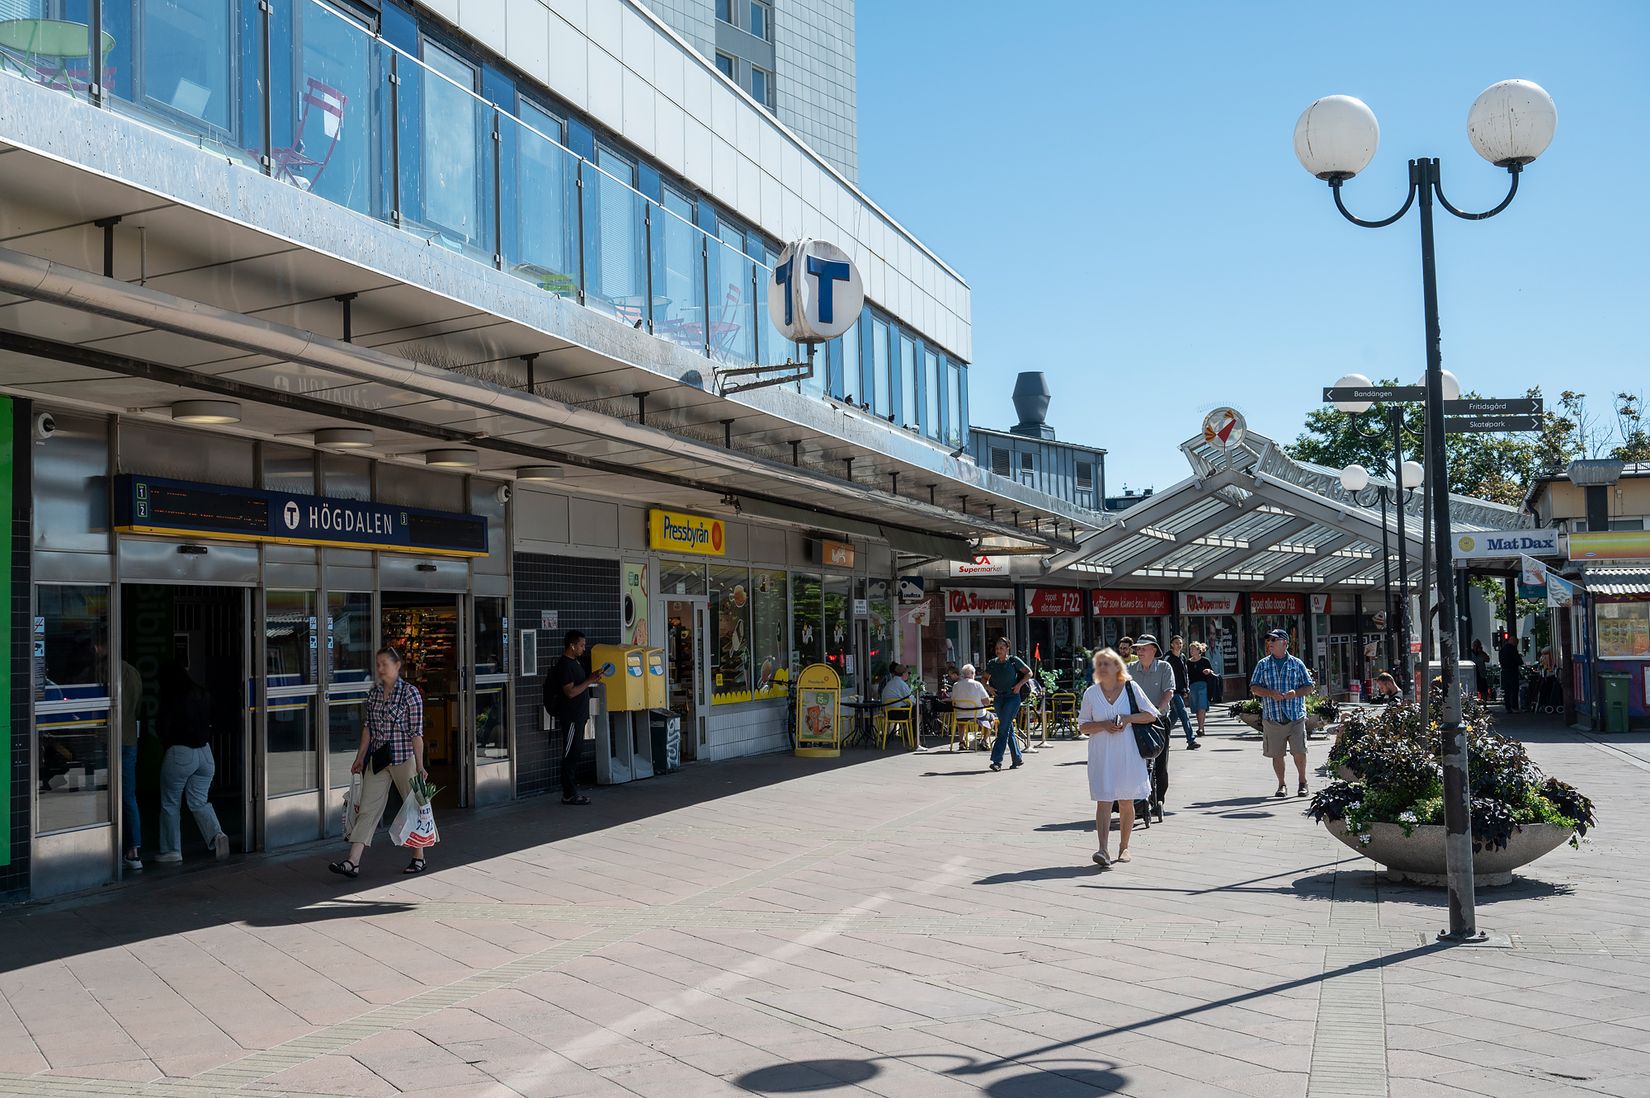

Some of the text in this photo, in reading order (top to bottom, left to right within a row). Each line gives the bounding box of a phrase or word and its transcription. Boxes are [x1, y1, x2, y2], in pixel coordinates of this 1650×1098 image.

[807, 255, 850, 324] T
[1353, 390, 1393, 398] Bandängen
[1469, 402, 1507, 411] Fritidsgård
[1469, 420, 1505, 429] Skatepark
[309, 503, 393, 535] HÖGDALEN
[663, 515, 709, 548] Pressbyrån
[1487, 537, 1554, 550] Mat Dax
[959, 565, 1003, 574] Supermarket
[949, 589, 970, 613] ICA
